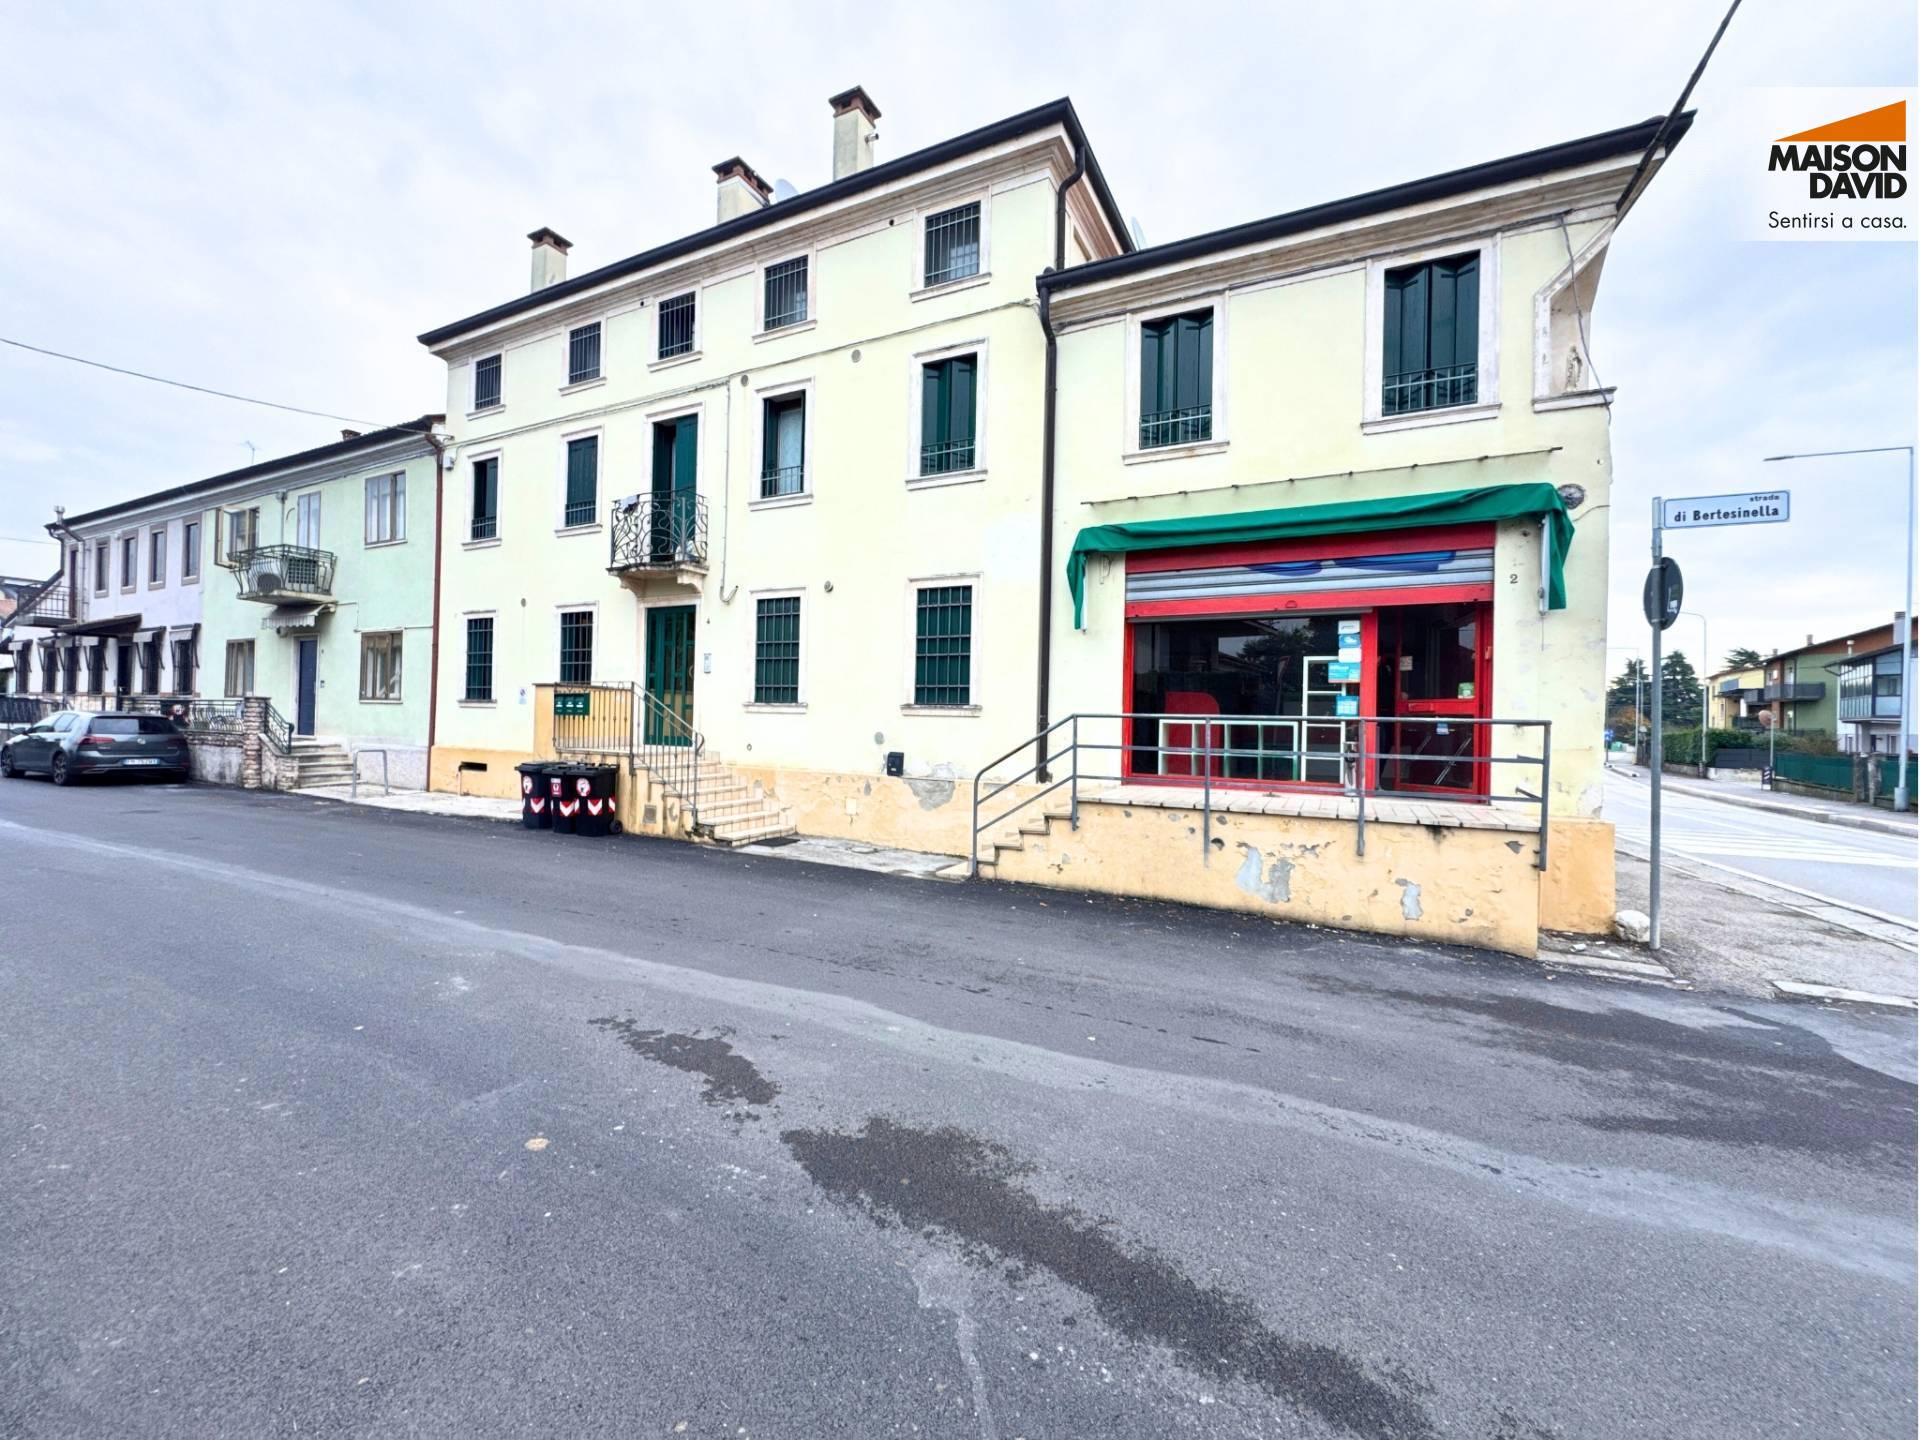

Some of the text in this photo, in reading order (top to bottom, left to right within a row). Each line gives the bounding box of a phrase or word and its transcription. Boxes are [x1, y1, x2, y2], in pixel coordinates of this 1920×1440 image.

[1749, 494, 1780, 502] strada
[1674, 505, 1780, 522] di Bertesinella
[1509, 573, 1518, 584] 2
